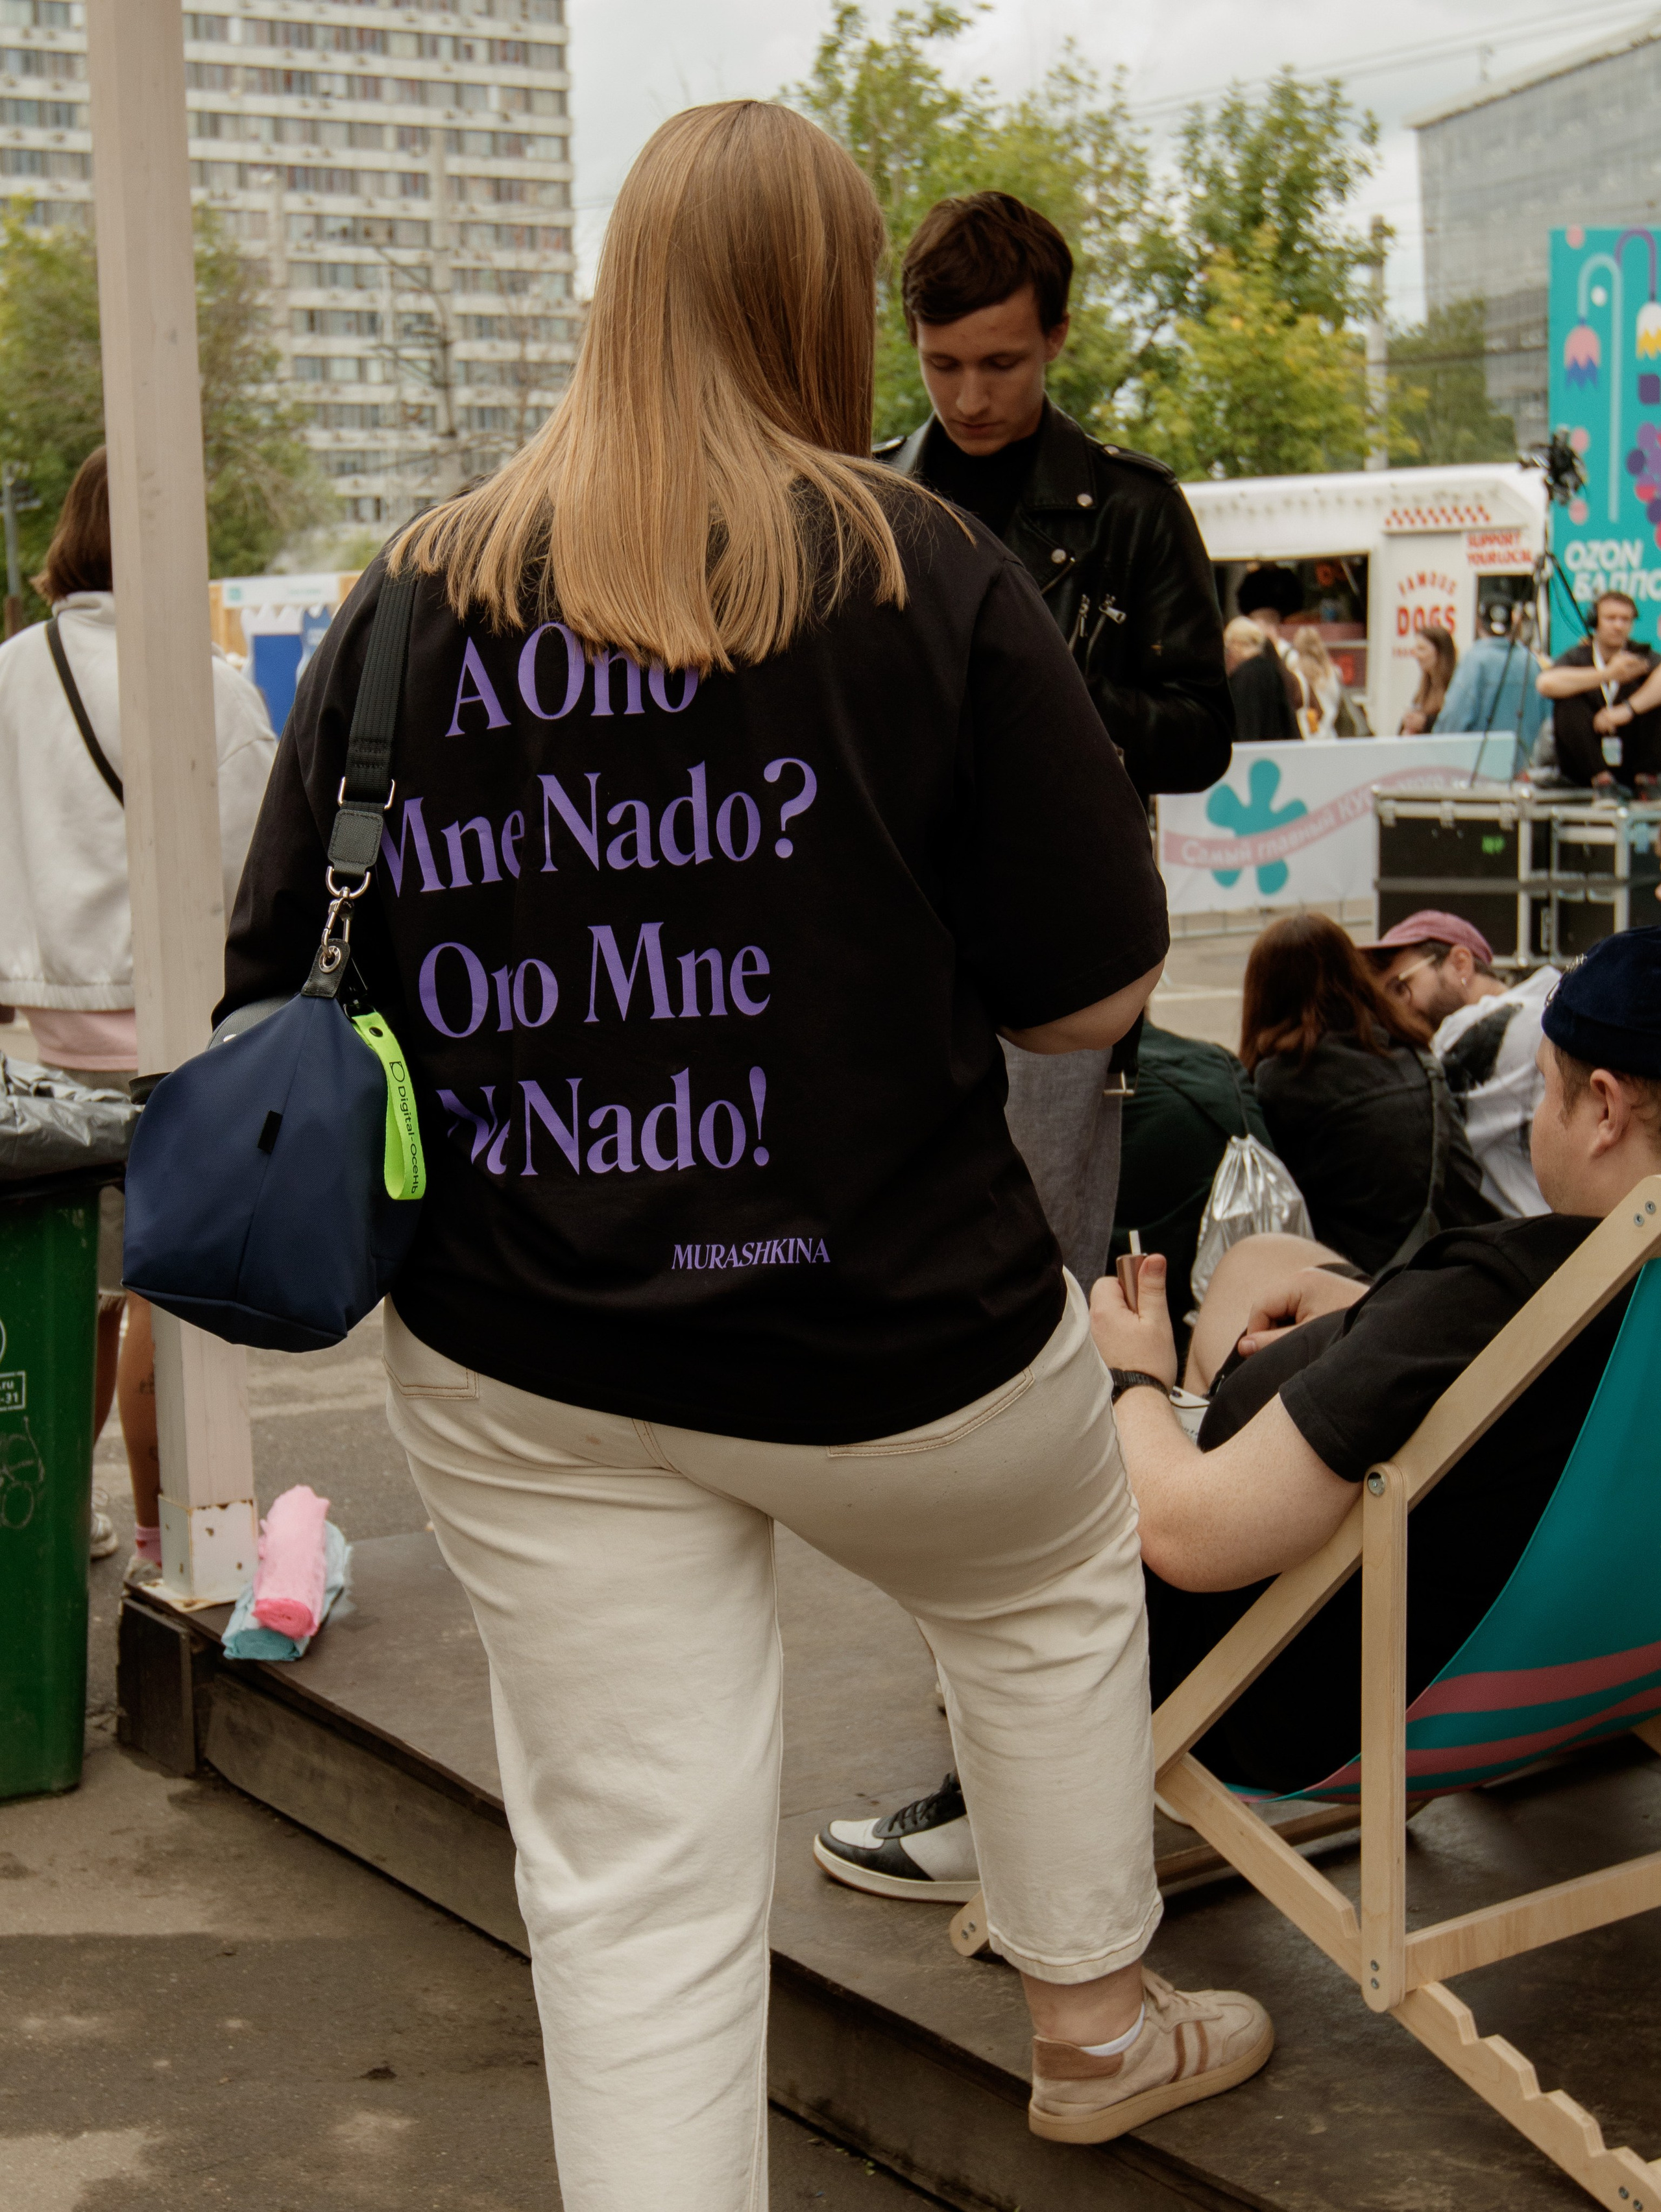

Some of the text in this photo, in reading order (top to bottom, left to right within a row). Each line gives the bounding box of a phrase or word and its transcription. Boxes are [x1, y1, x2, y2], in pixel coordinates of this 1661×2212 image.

[1565, 539, 1643, 571] OZON
[1397, 605, 1456, 637] DOGS
[445, 622, 699, 737] A Ono
[537, 758, 818, 872] Nado?
[585, 922, 771, 1022] Mne
[518, 1066, 770, 1175] Nado!
[672, 1238, 830, 1269] MURASHKINA
